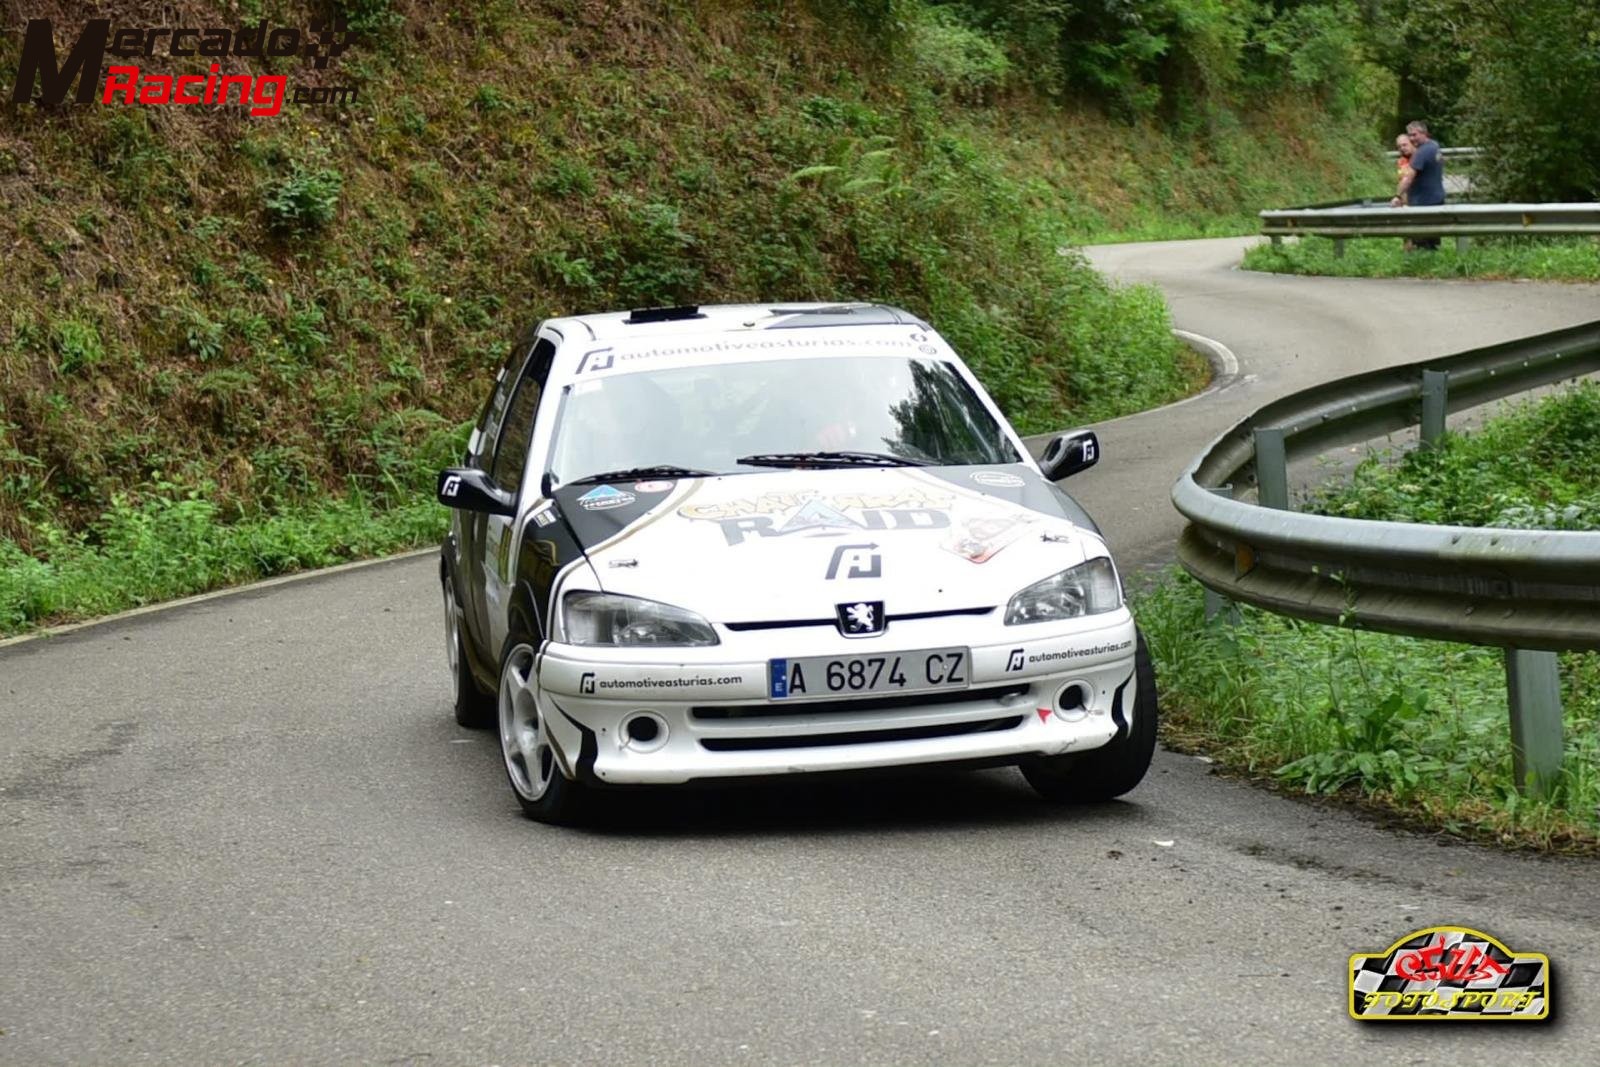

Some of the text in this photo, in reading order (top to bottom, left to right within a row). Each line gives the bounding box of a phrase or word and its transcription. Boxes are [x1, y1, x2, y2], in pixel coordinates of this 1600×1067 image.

[619, 337, 914, 362] automotiveasturias.com
[1028, 640, 1132, 663] automotiveasturias.com
[599, 675, 742, 689] automotiveasturias.com
[789, 663, 807, 694] A
[826, 657, 906, 691] 6874
[925, 653, 964, 685] CZ
